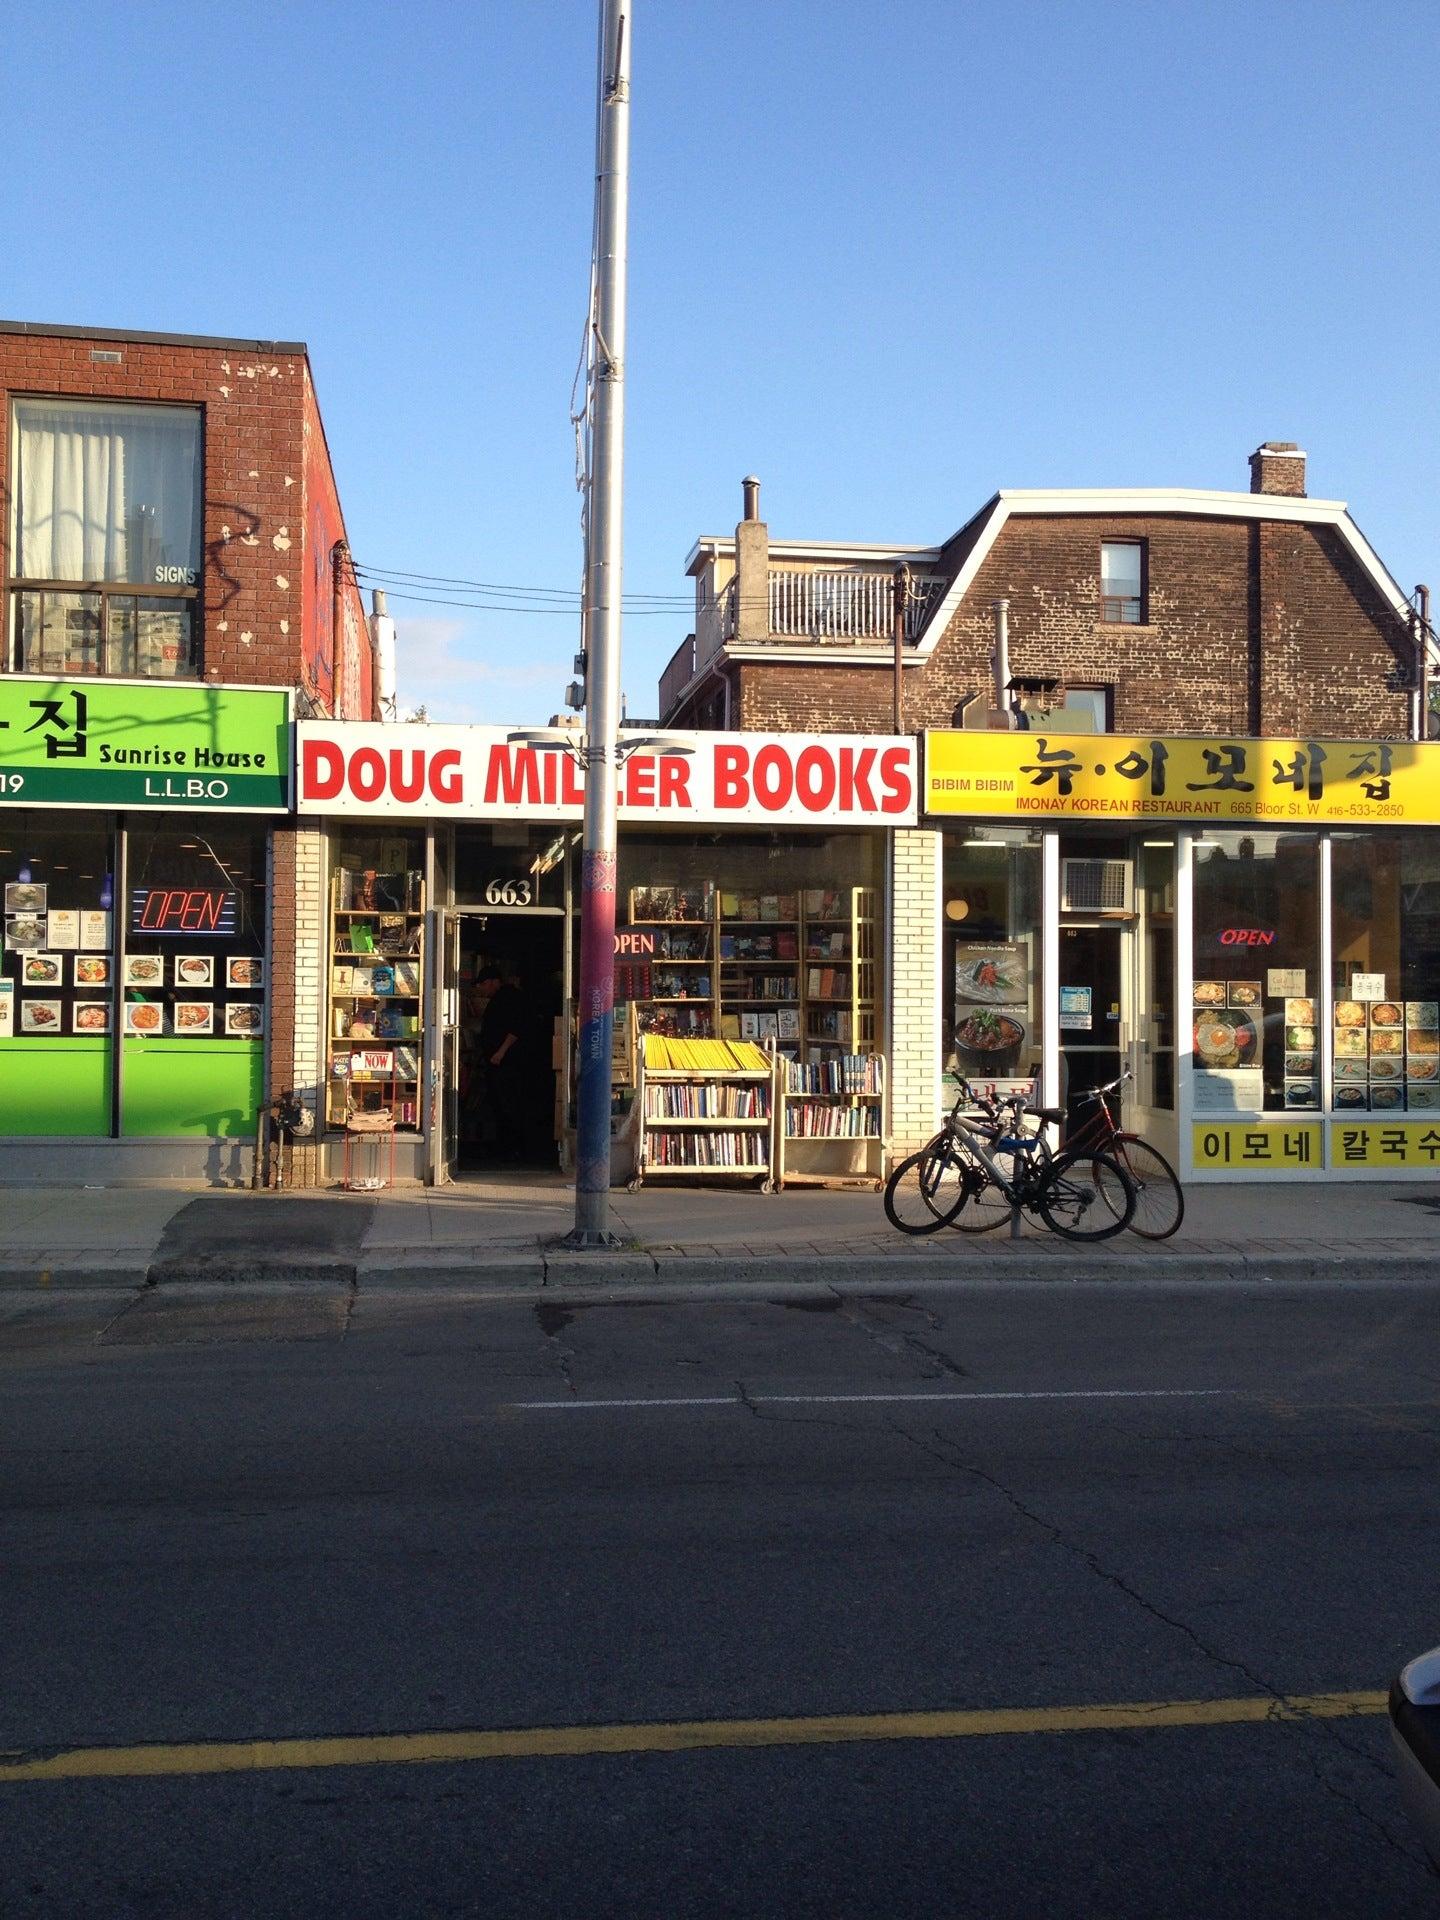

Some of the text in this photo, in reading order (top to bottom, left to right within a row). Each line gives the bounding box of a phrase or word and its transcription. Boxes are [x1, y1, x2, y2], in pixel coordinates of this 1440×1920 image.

[155, 565, 196, 585] SIGNS
[99, 744, 266, 769] Sunrise House
[145, 777, 229, 799] L.L.B.O
[303, 739, 912, 814] DOUG MILER BOOKS
[931, 778, 1014, 792] BIBIM BIBIM
[1016, 797, 1404, 817] IMONAY KOREAN RESTAURANT 665 Bloor St. W 416-533-2850
[486, 878, 531, 906] 663
[141, 891, 225, 930] OPEN
[1221, 928, 1275, 945] OPEN
[591, 989, 601, 1059] KOREA TOWN
[364, 1054, 389, 1069] NOW
[1203, 1131, 1310, 1162] 이모네
[1342, 1130, 1440, 1161] 칼국수
